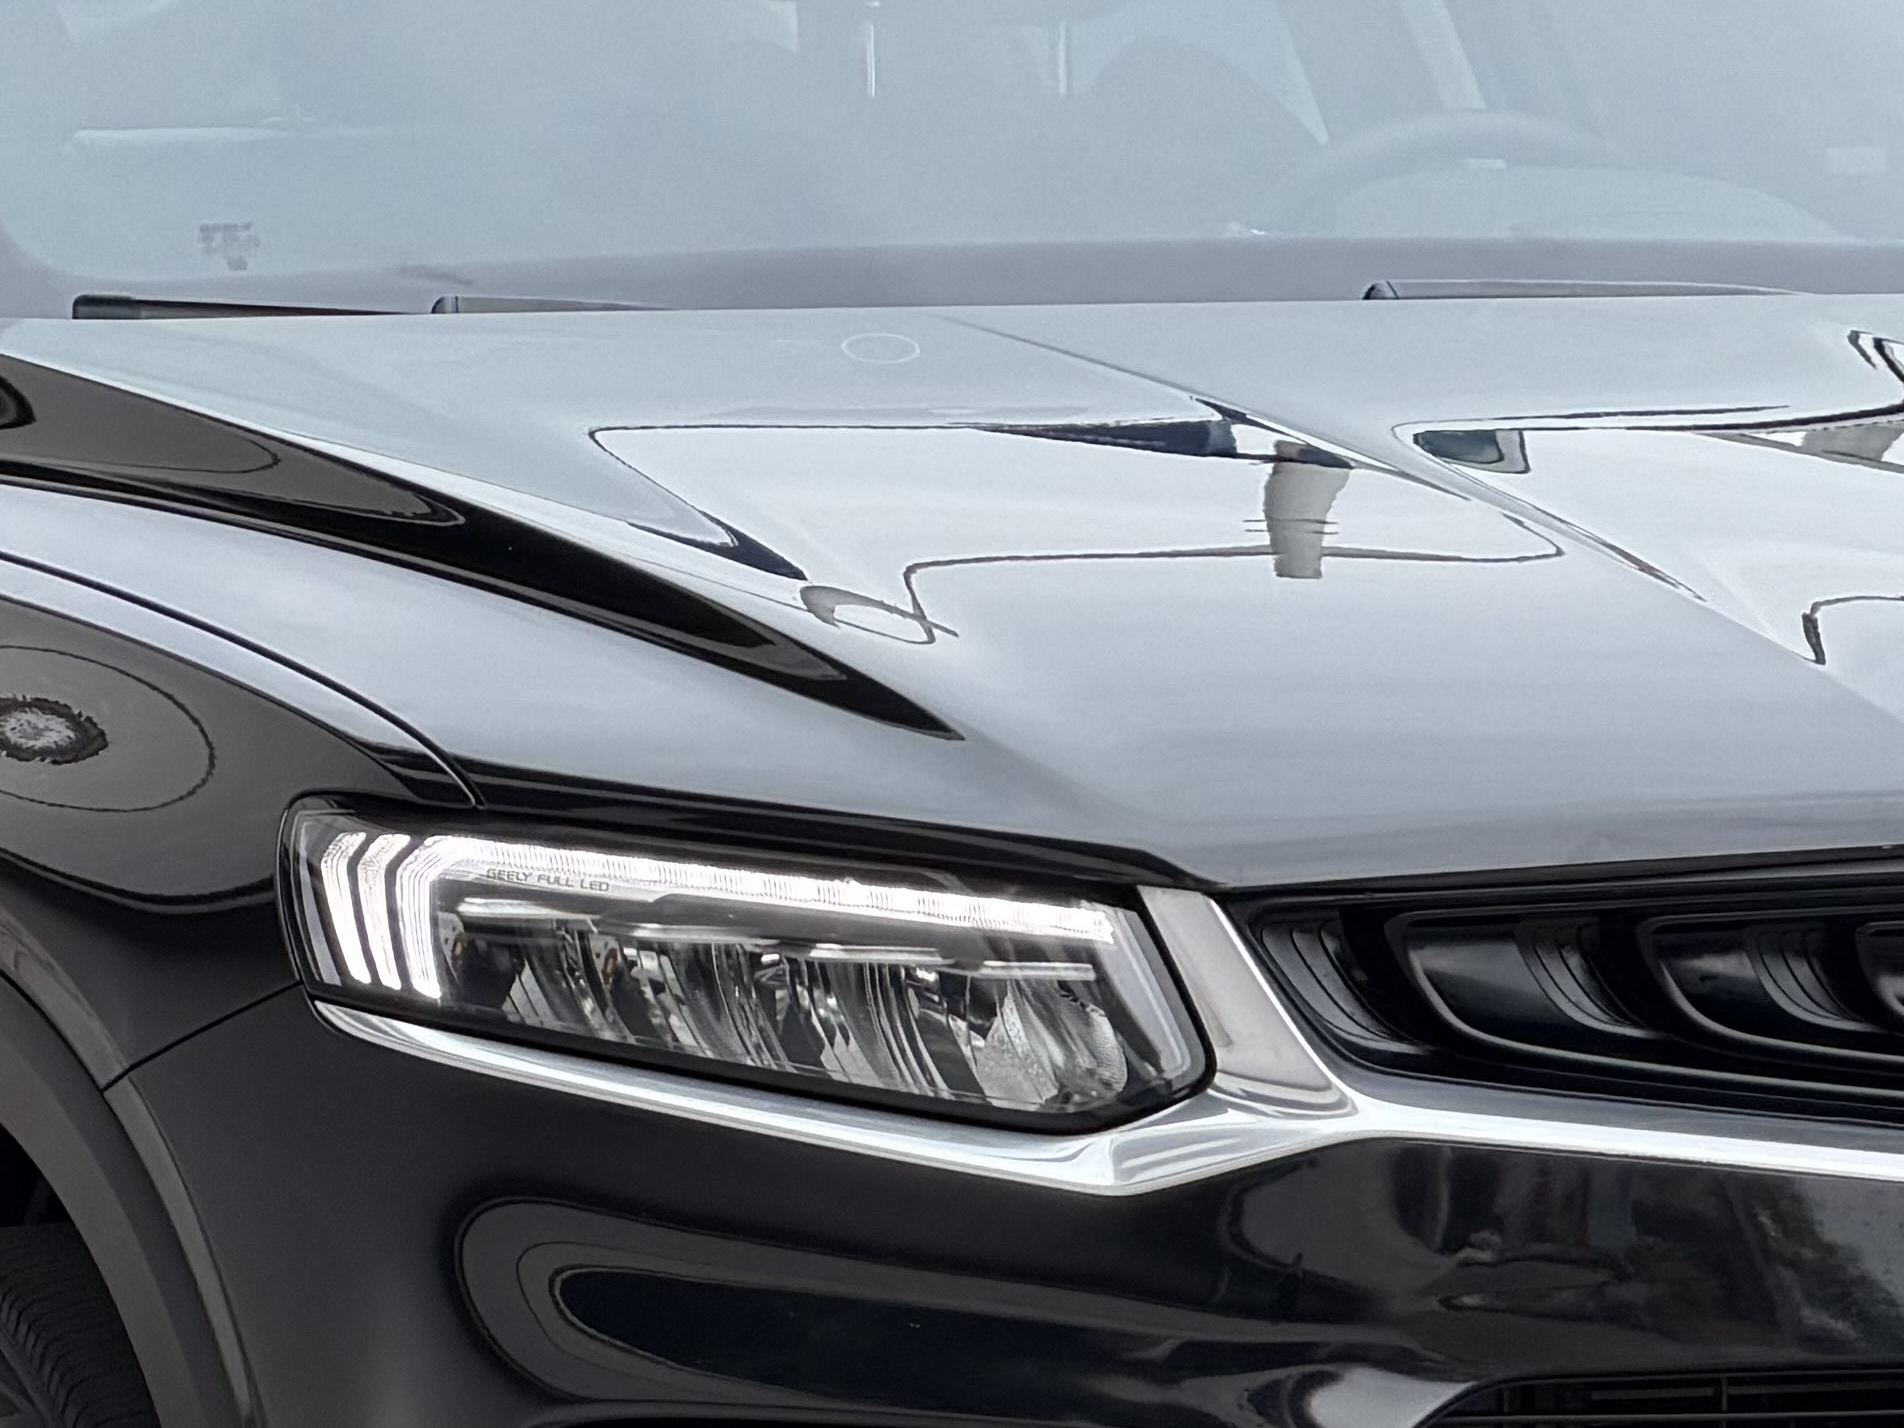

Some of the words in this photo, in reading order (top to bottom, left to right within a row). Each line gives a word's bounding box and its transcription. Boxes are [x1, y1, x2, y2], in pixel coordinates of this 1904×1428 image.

[486, 868, 533, 882] GEELY
[537, 873, 575, 887] FULL
[580, 878, 610, 892] LED
